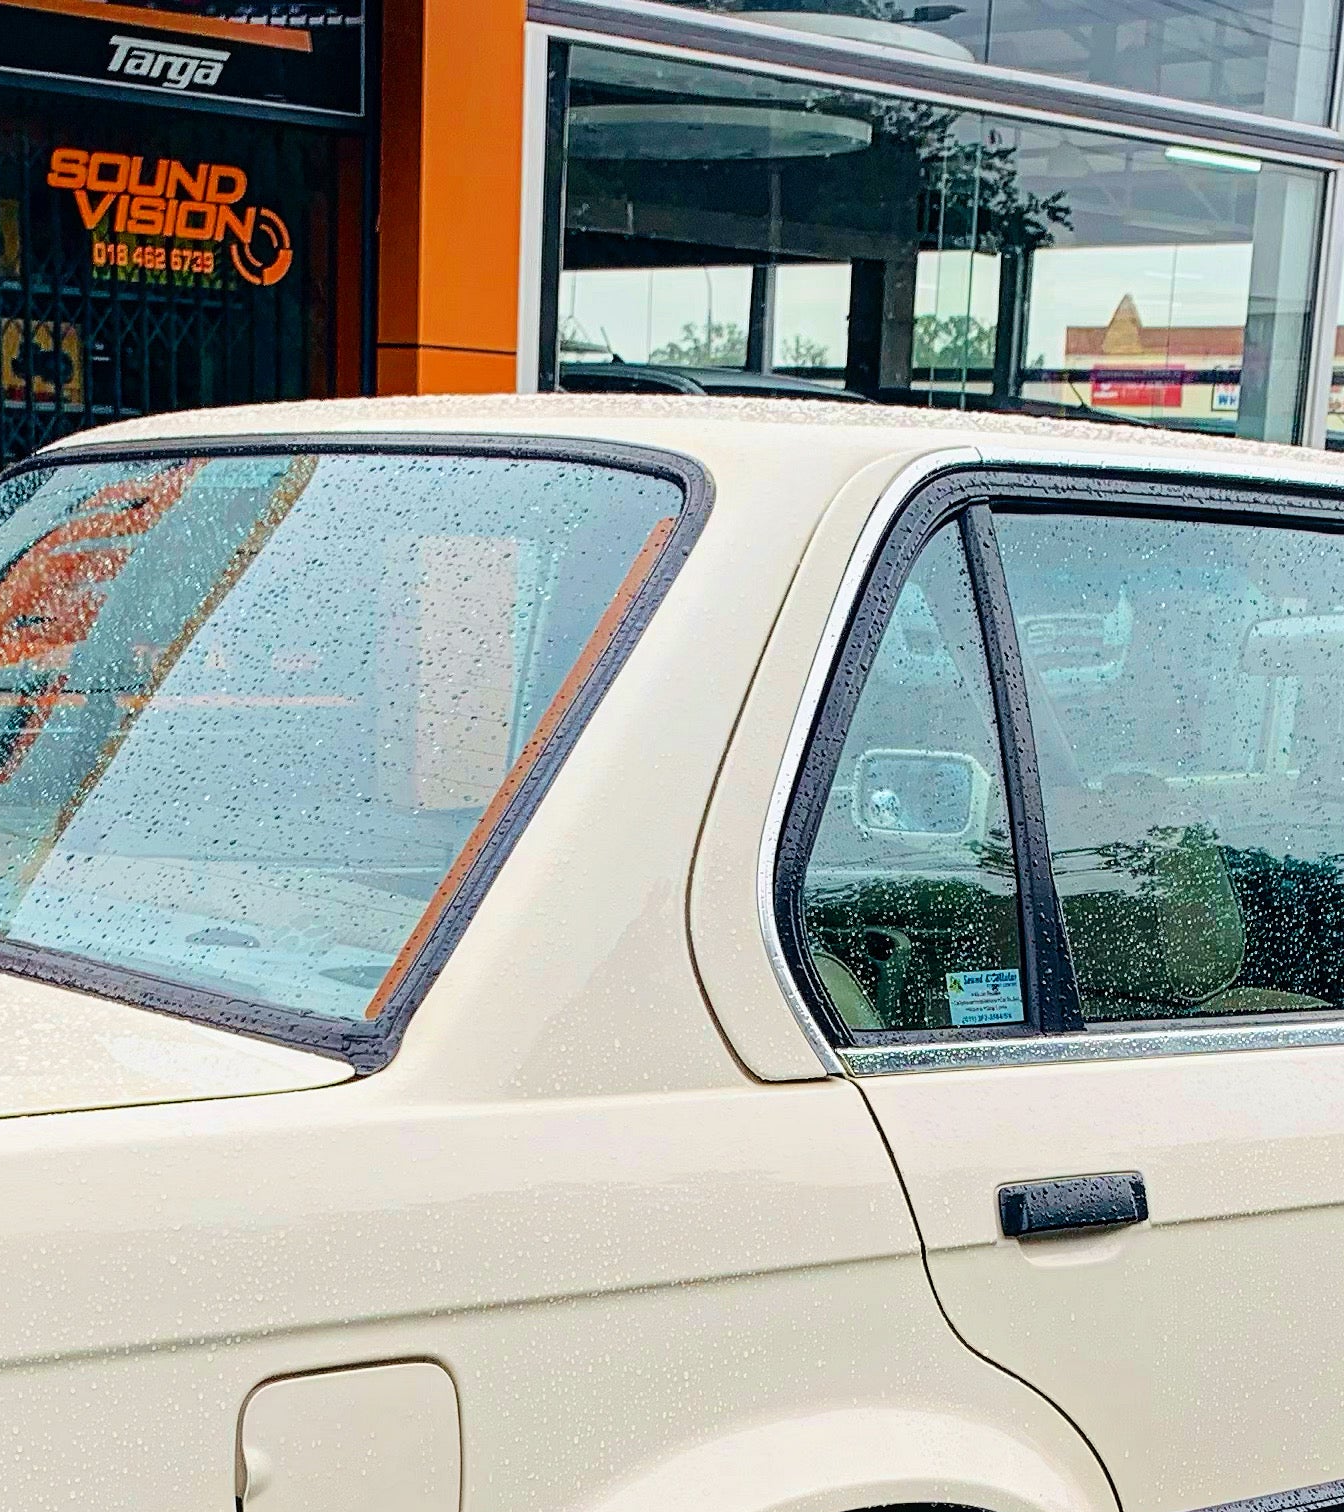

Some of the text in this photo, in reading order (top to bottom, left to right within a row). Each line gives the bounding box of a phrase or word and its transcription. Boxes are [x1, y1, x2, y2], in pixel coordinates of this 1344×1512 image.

[107, 34, 231, 89] Targa
[47, 147, 247, 204] SOUND
[75, 190, 255, 243] VISION
[132, 246, 166, 271] 462
